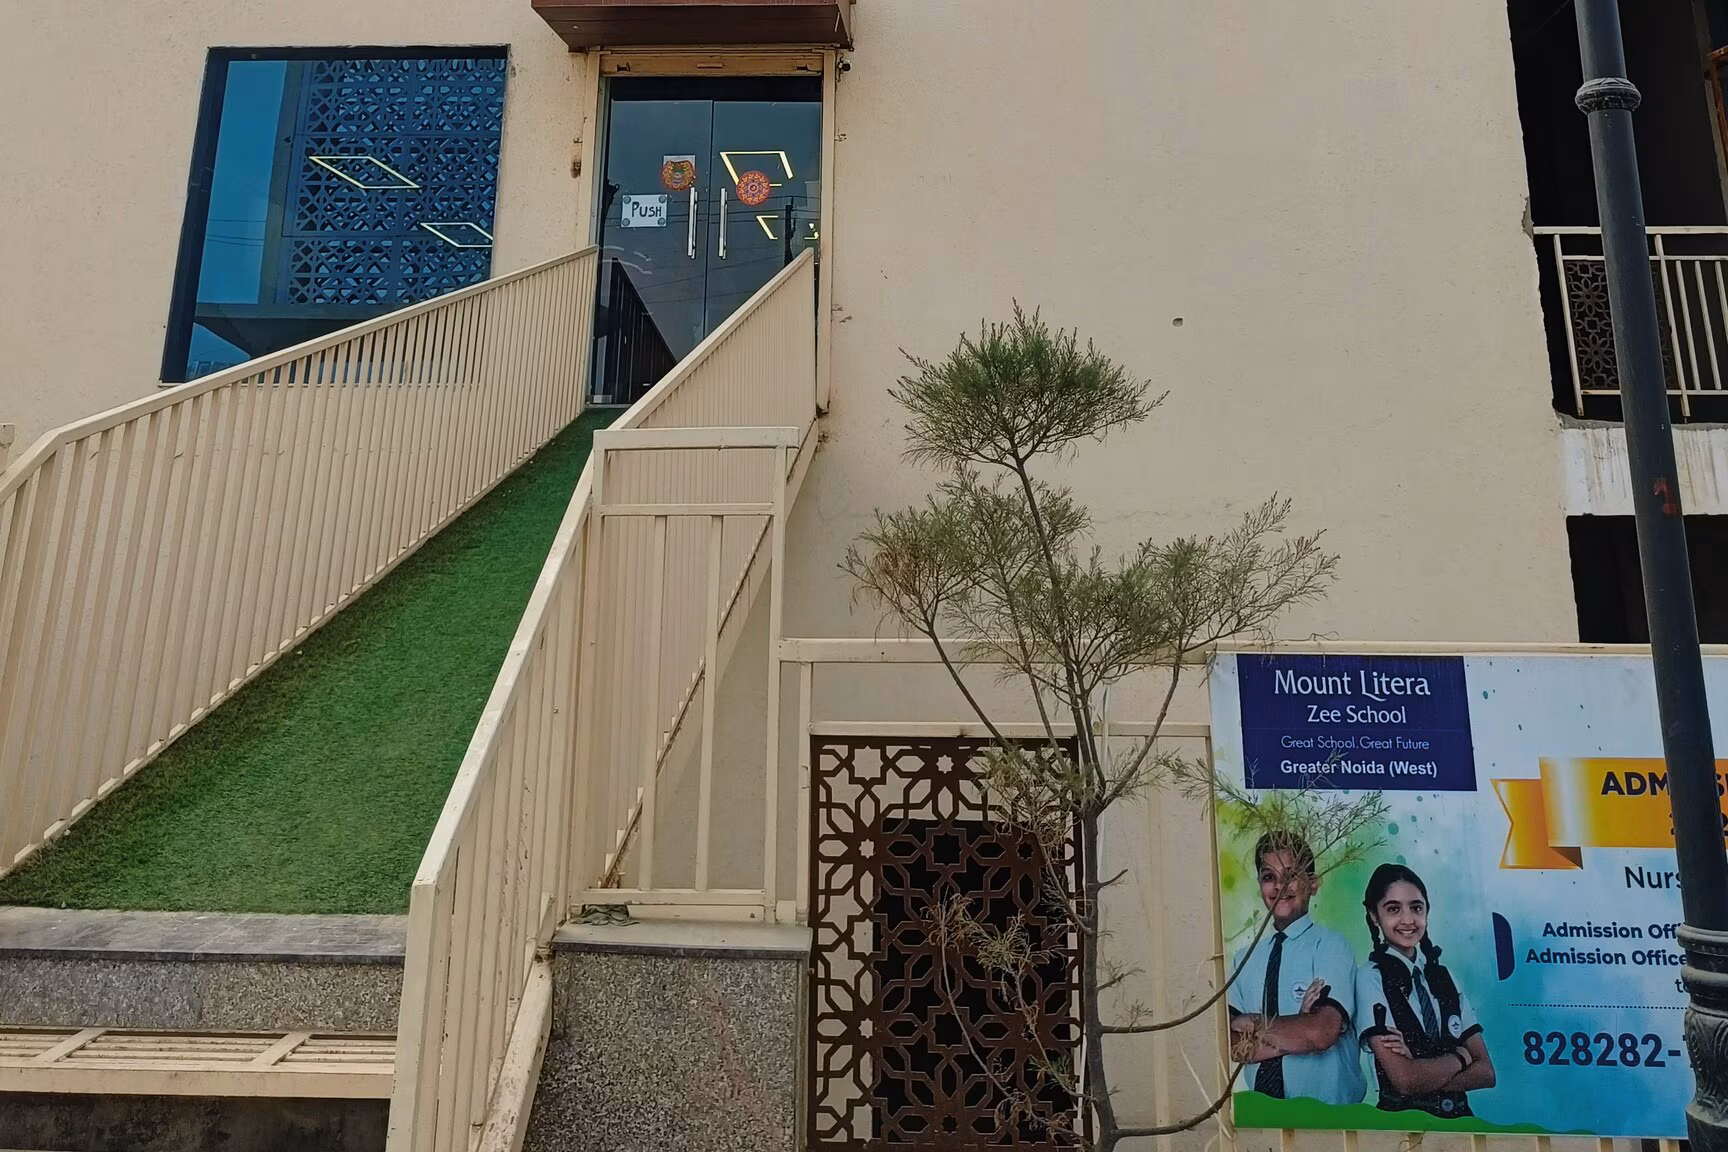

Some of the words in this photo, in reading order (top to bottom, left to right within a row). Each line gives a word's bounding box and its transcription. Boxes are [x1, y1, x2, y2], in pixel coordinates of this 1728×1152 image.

[1274, 669, 1352, 695] Mount
[1359, 669, 1431, 702] Litera
[1307, 704, 1341, 723] Zee
[1346, 705, 1407, 724] School
[1281, 735, 1314, 748] Great
[1396, 737, 1430, 750] Future
[1280, 759, 1337, 774] Greater
[1341, 761, 1385, 774] Noida
[1389, 761, 1438, 778] (West)
[1542, 921, 1643, 939] Admission
[1525, 947, 1627, 966] Admission
[1523, 1030, 1692, 1068] 828282-
